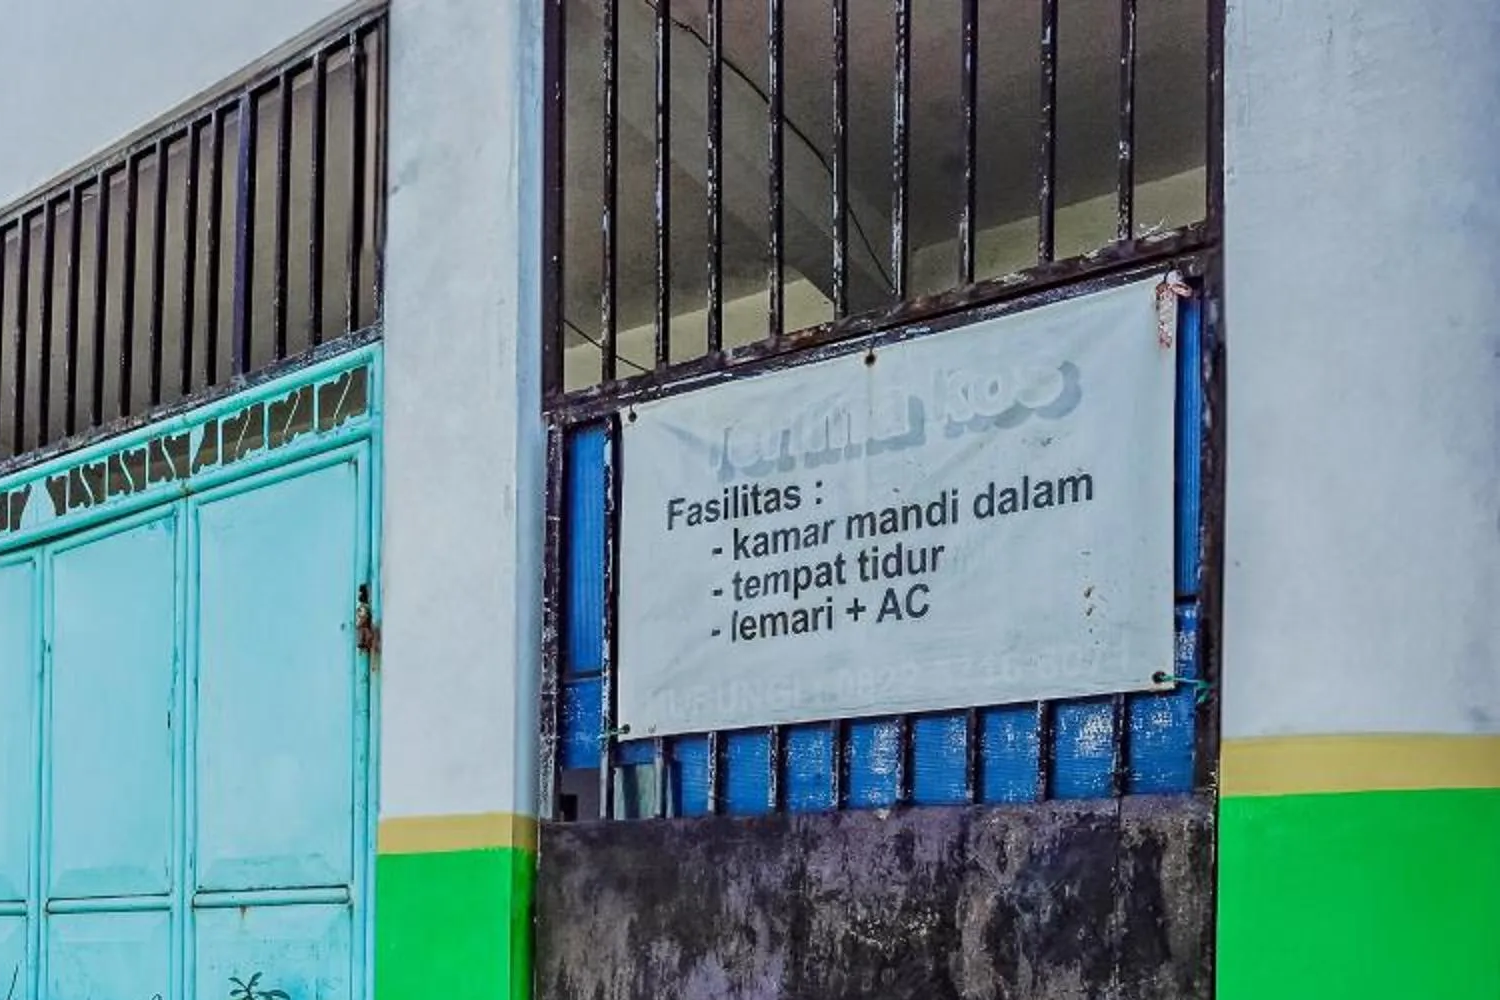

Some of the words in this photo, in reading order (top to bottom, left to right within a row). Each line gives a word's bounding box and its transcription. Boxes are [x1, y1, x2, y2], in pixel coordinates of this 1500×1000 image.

[666, 483, 802, 531] Fasilitas
[732, 518, 837, 561] kamar
[845, 488, 959, 541] mandi
[972, 472, 1094, 520] dalam
[731, 551, 847, 601] tempat
[856, 541, 946, 583] tidur
[730, 595, 834, 643] lemari
[875, 583, 931, 624] AC
